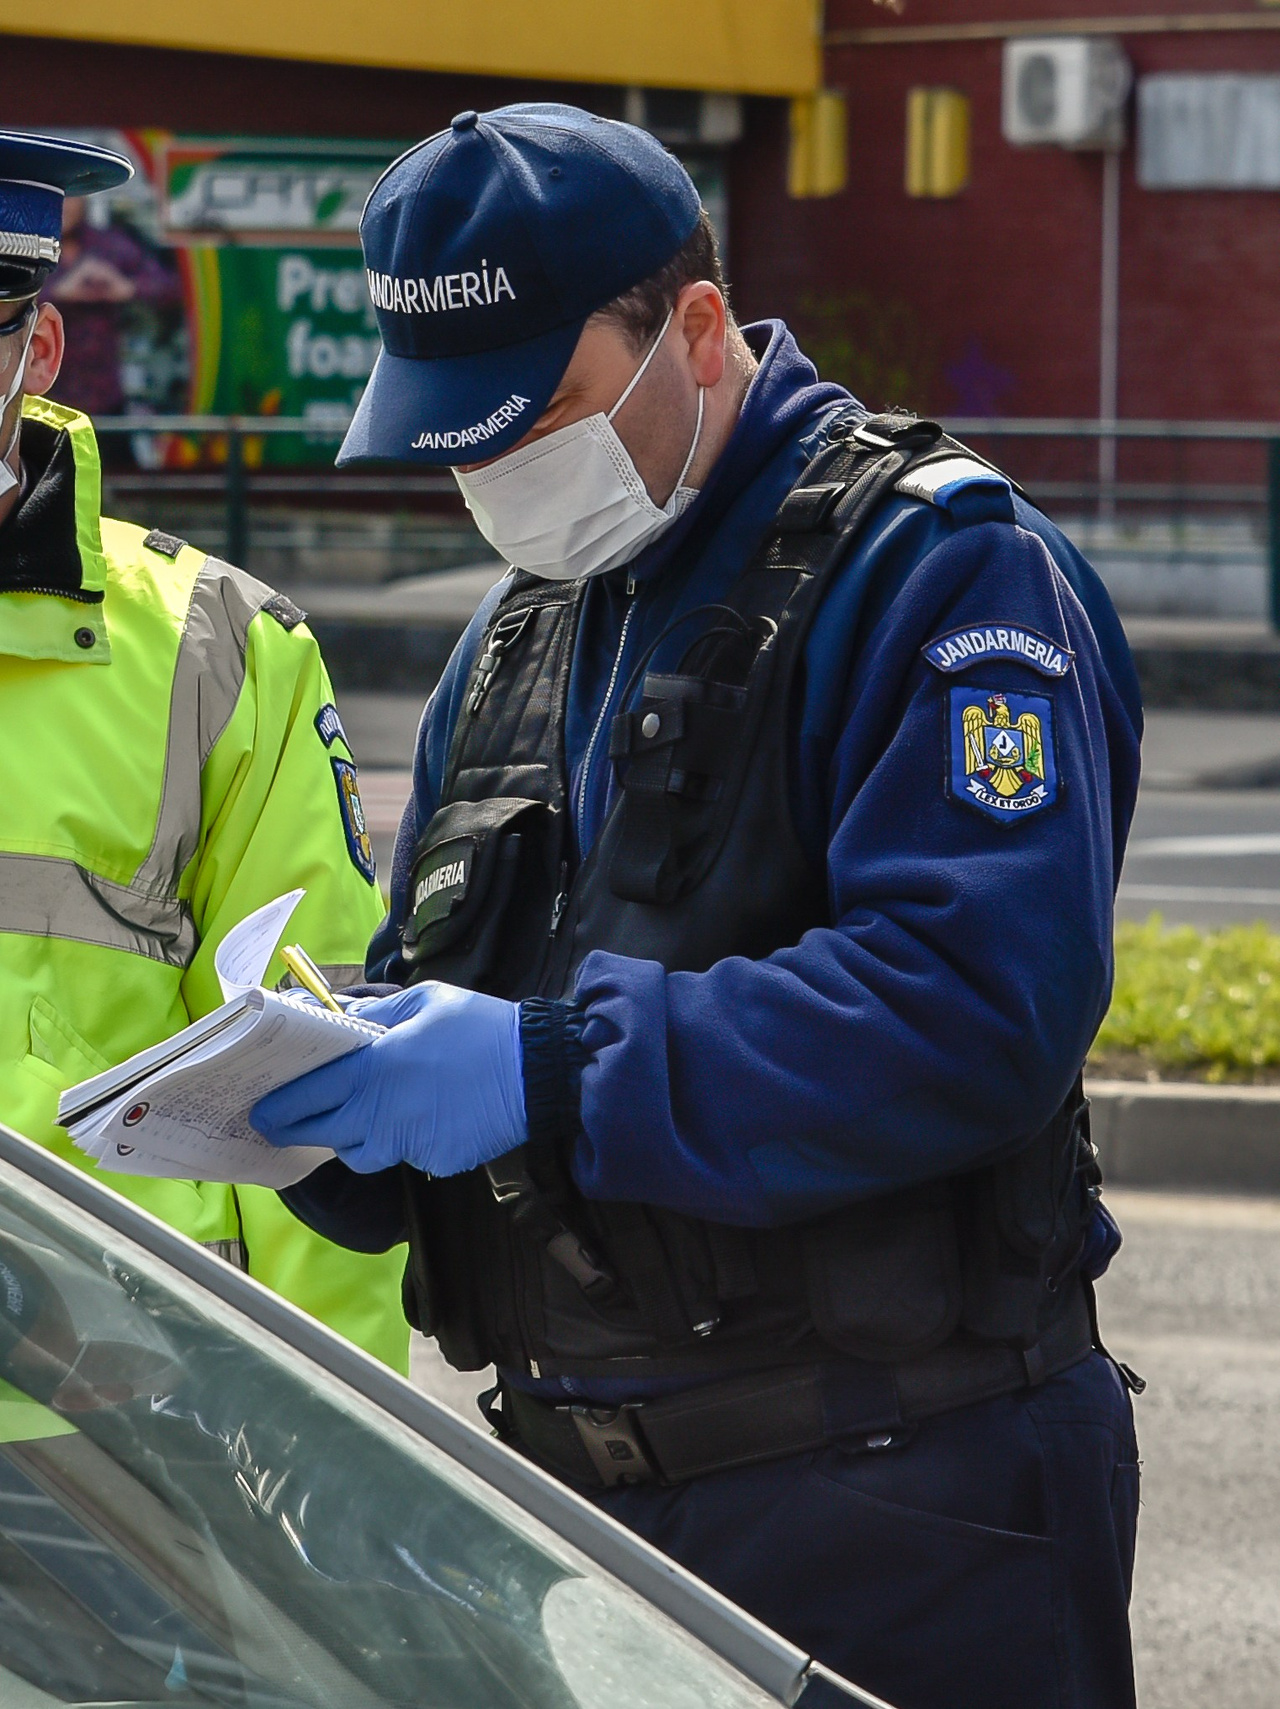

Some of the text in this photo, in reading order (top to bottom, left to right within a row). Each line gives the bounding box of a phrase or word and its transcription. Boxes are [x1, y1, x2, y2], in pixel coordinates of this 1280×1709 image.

[276, 253, 374, 324] Pre
[978, 790, 998, 806] LEX
[1012, 795, 1039, 809] ORDO
